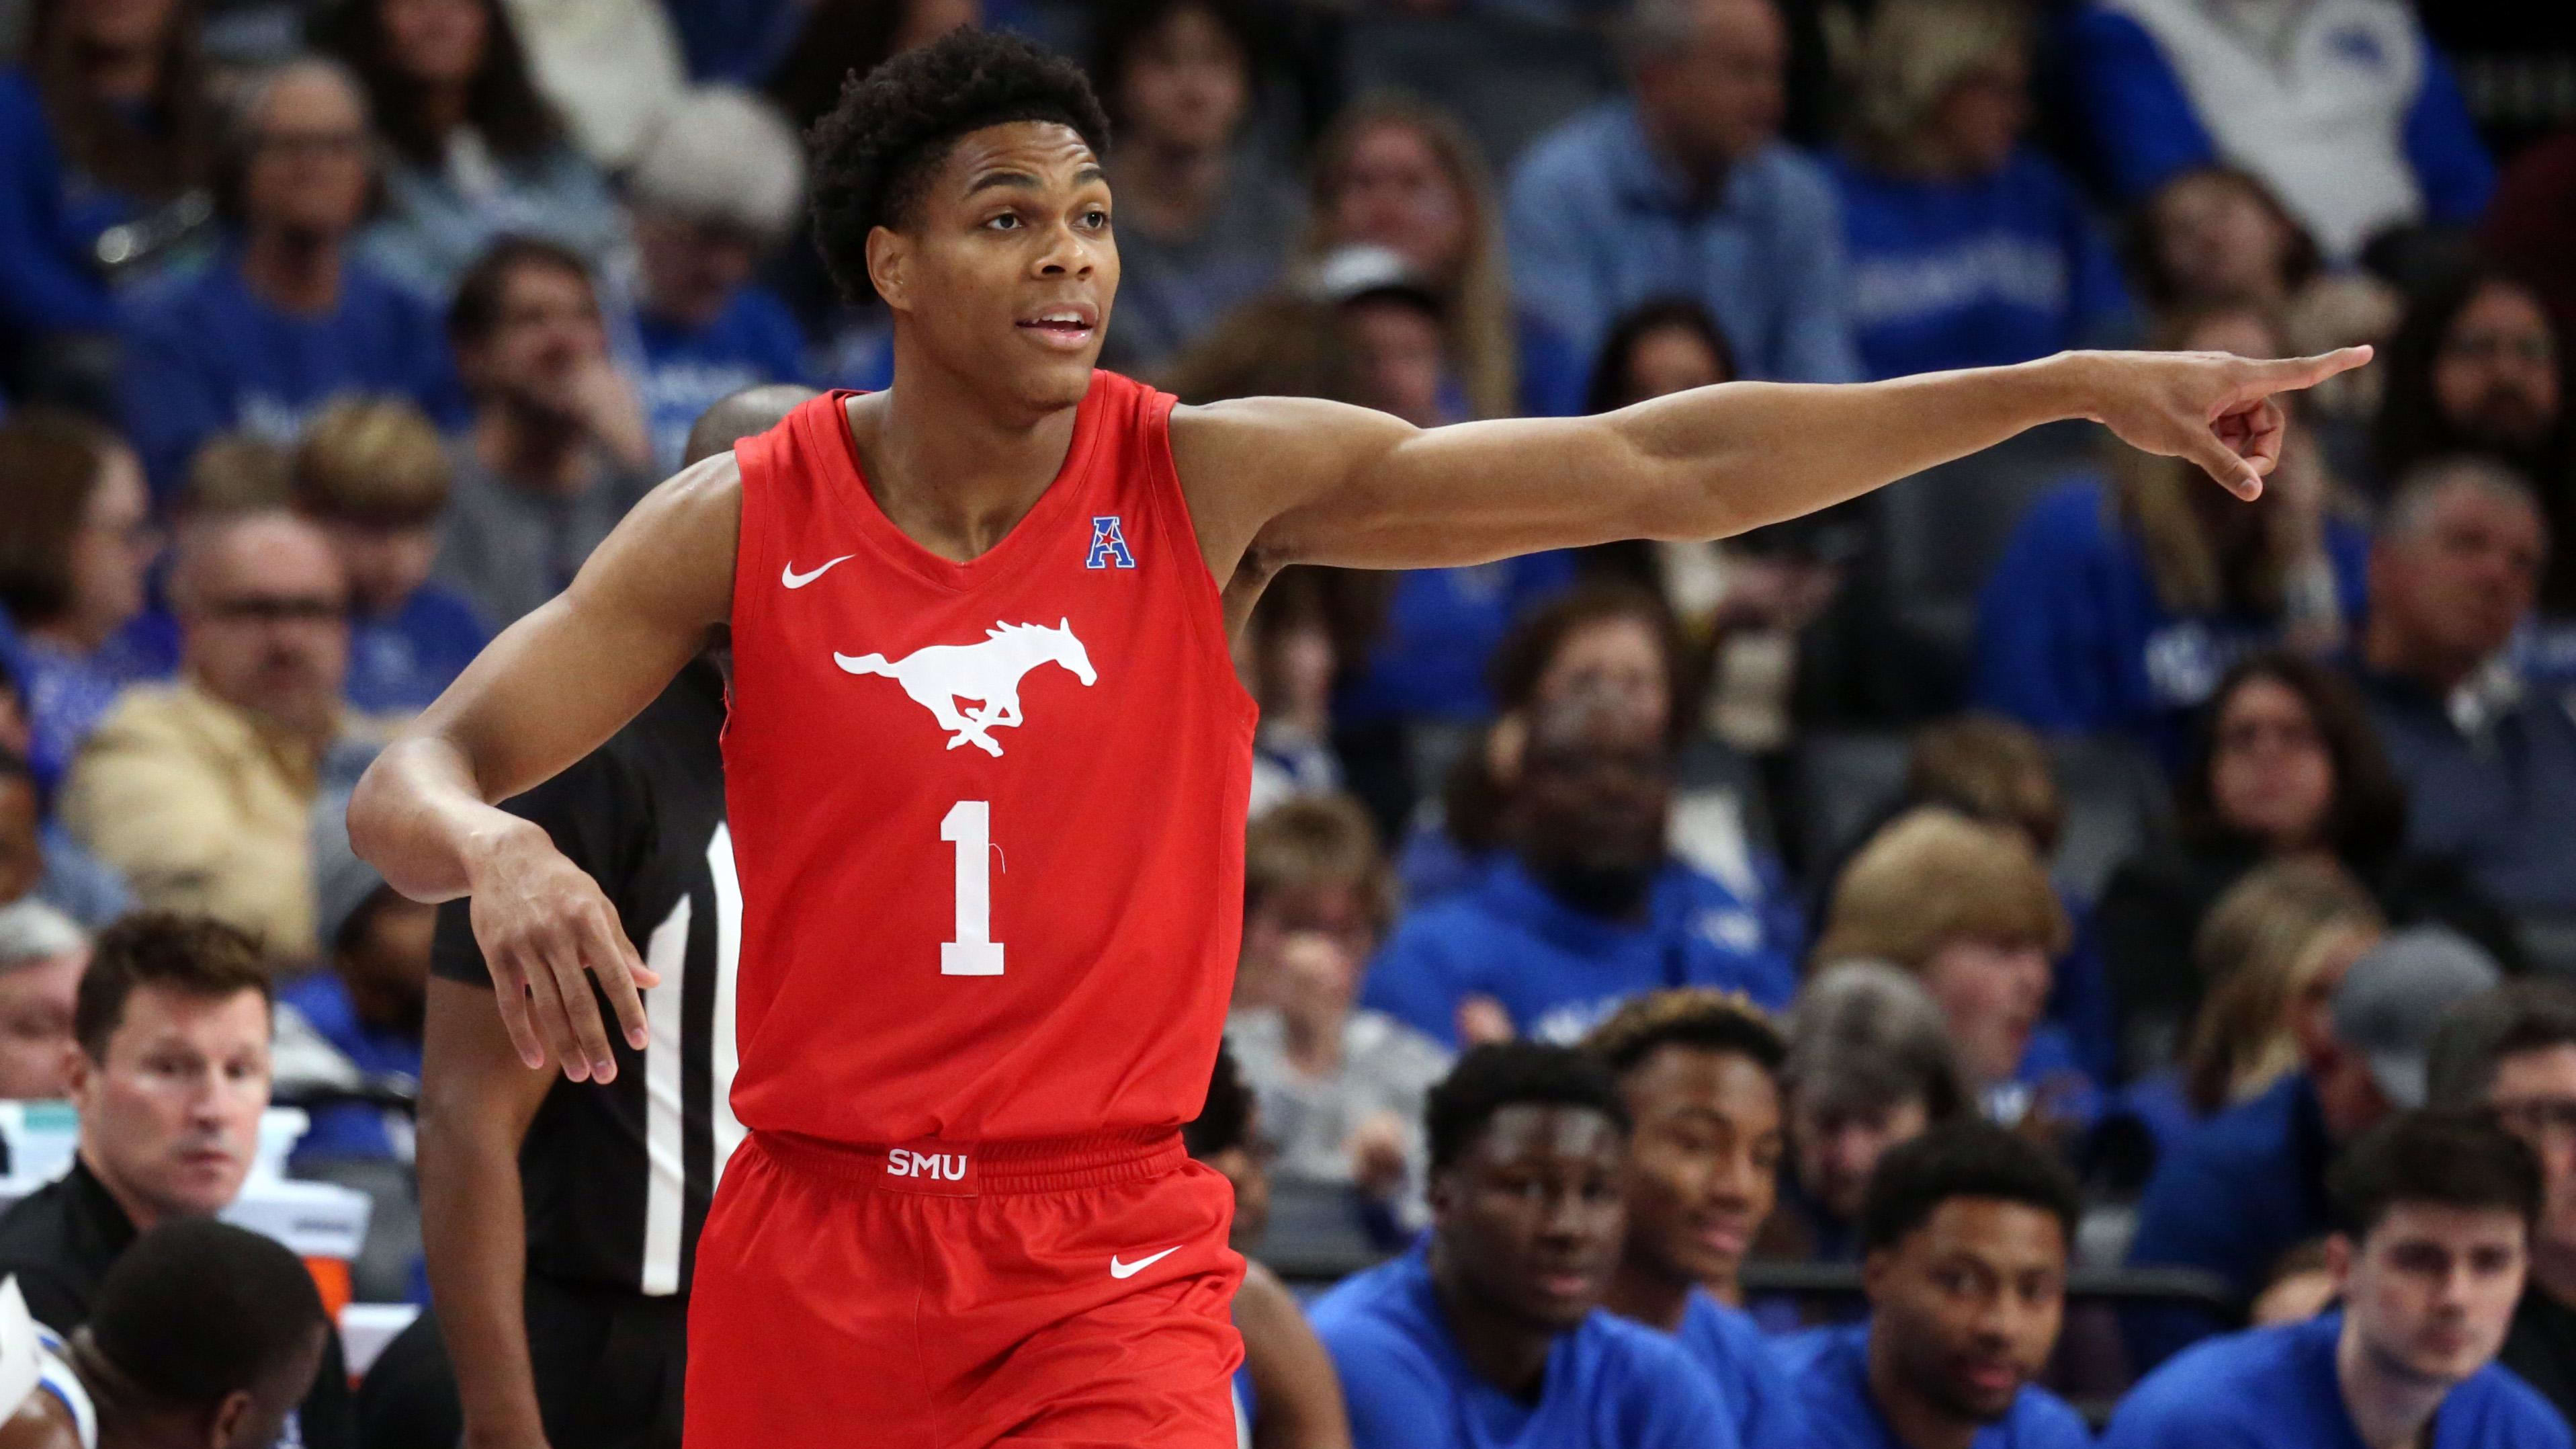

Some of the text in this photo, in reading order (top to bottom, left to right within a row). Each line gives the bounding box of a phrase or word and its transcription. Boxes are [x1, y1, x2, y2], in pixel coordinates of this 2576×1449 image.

[1086, 517, 1135, 569] A
[941, 800, 1004, 976] 1
[887, 1148, 967, 1181] SMU
